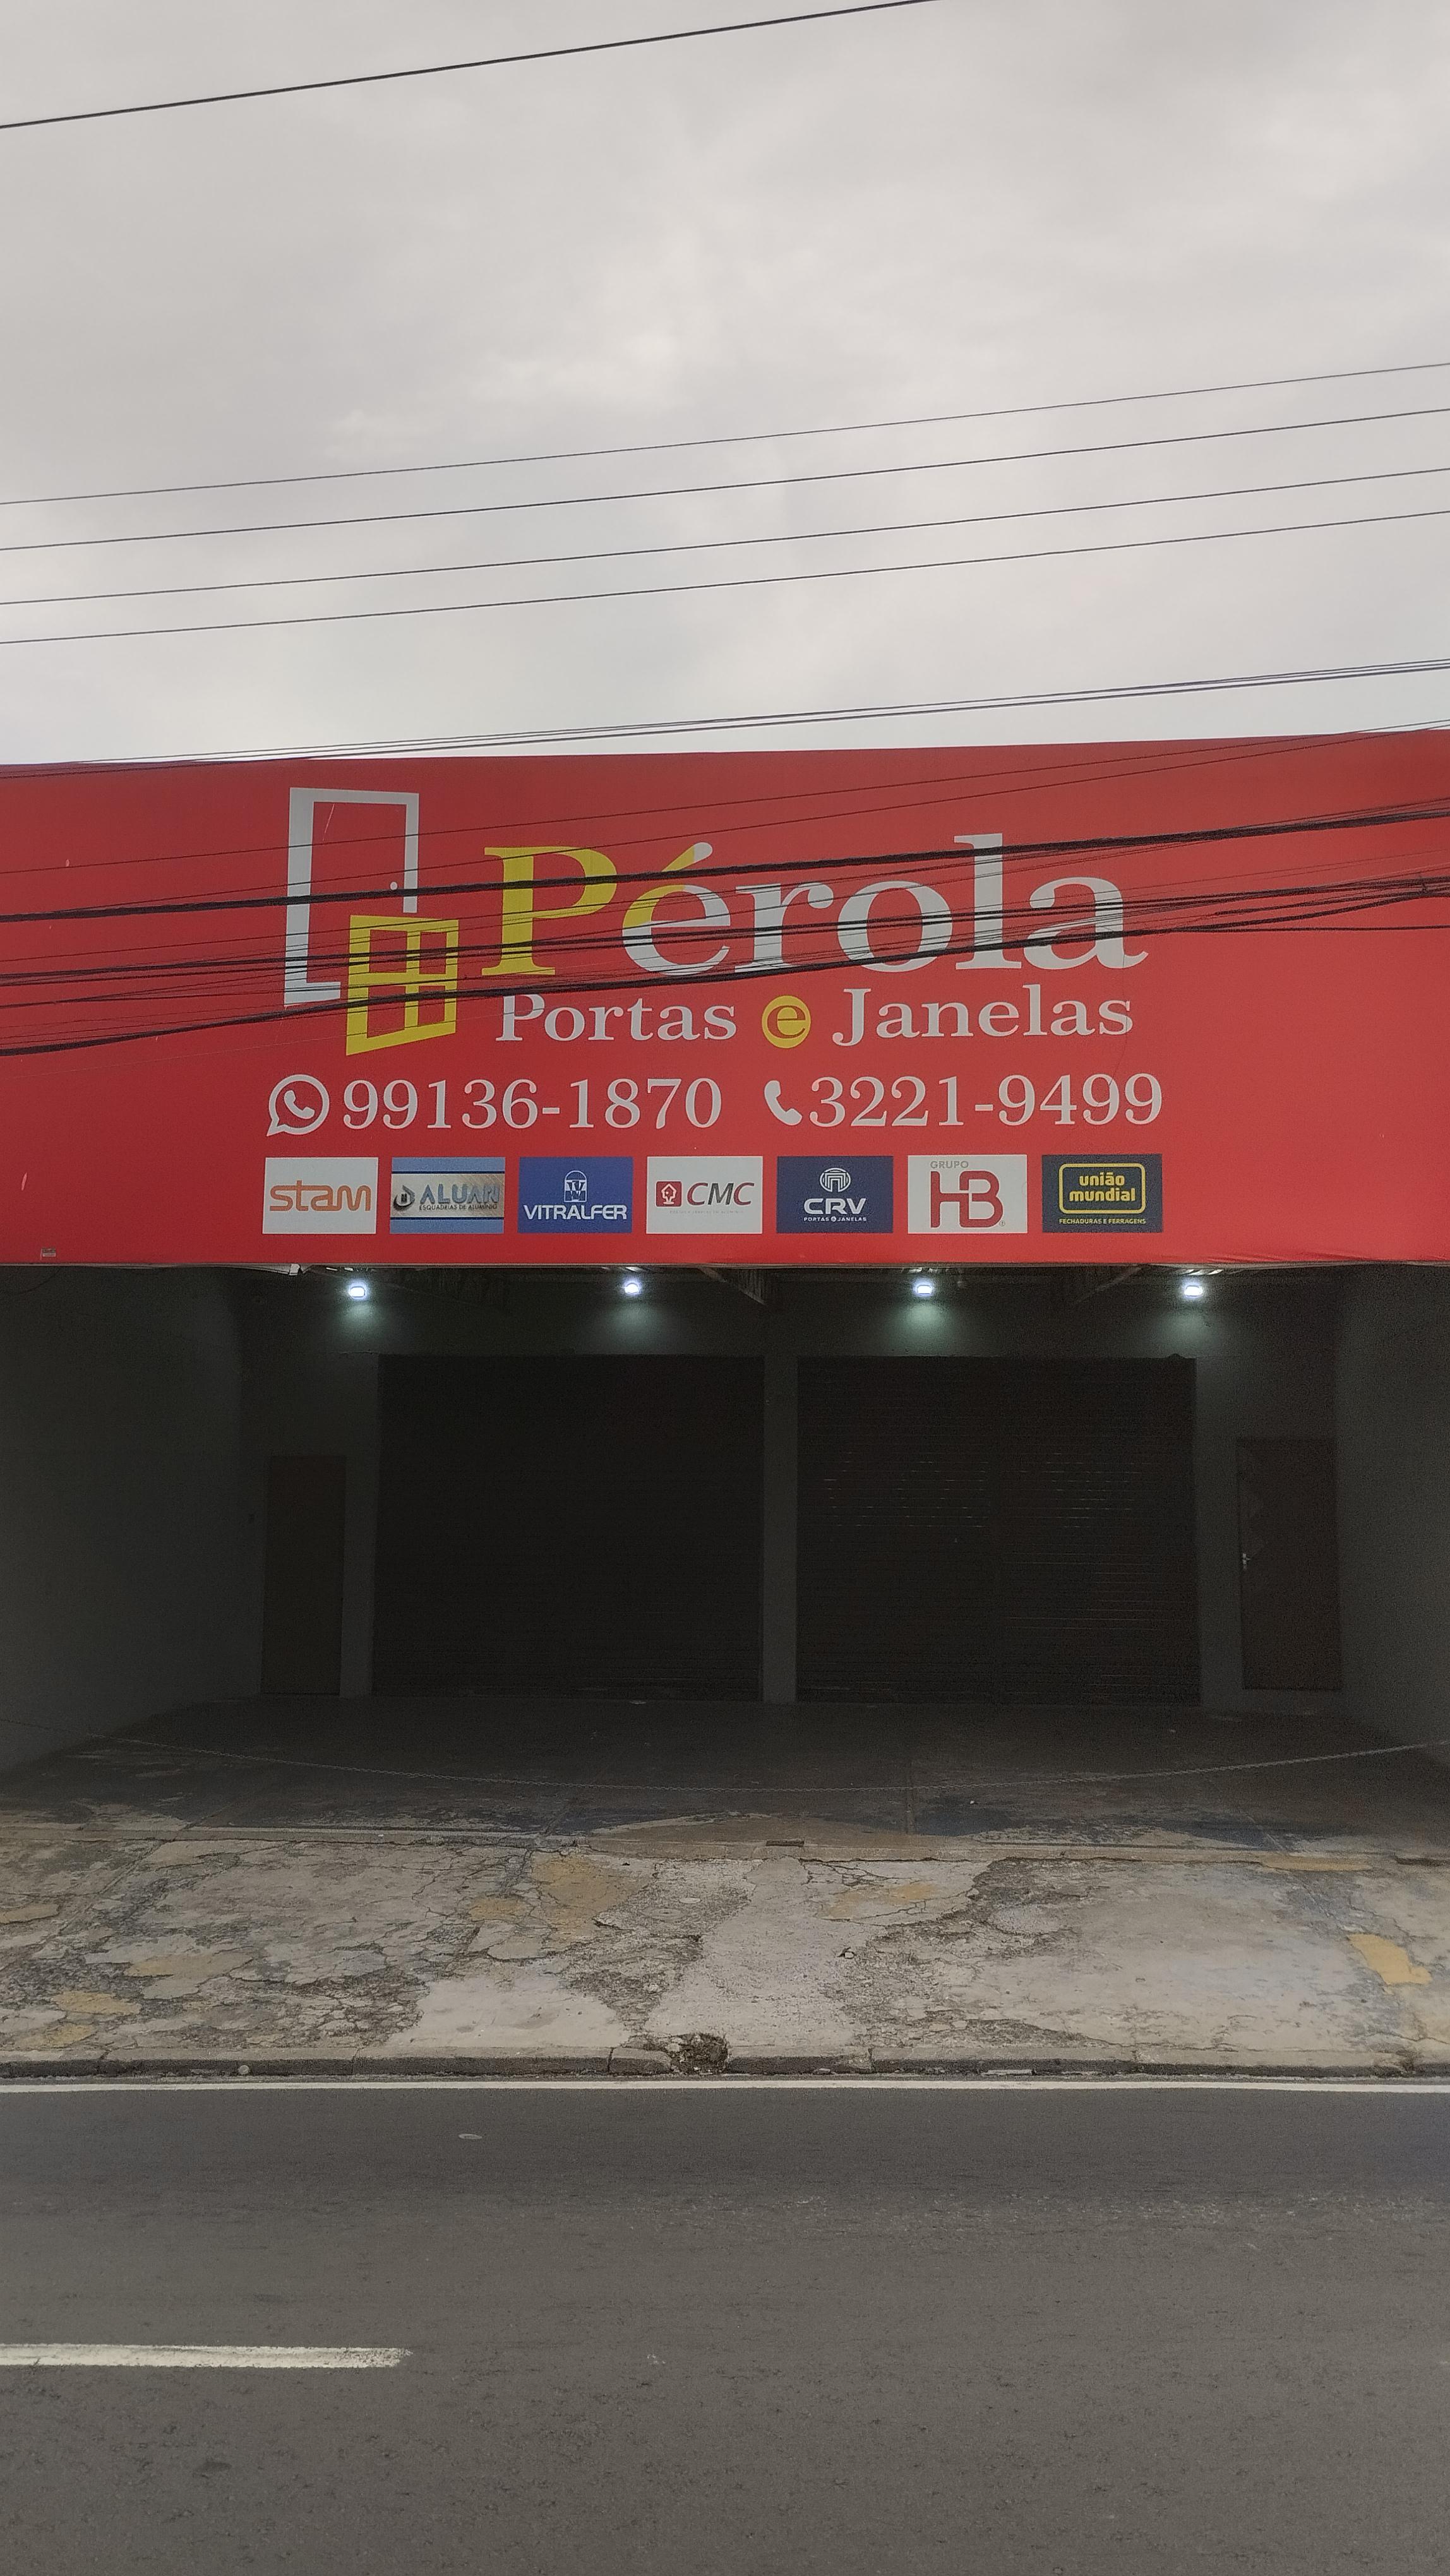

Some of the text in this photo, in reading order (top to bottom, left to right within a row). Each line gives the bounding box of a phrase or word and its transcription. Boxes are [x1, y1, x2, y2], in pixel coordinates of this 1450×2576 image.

[482, 832, 1149, 976] Pérola
[495, 984, 1134, 1049] Portas e Janelas
[343, 1077, 722, 1131] 99136-1870
[808, 1073, 1163, 1128] 3221-9499
[930, 1160, 969, 1169] GRUPO
[1079, 1171, 1125, 1186] união
[270, 1179, 371, 1212] stam
[686, 1182, 755, 1206] CMC
[804, 1198, 866, 1215] CRV
[930, 1171, 1003, 1228] HB
[1069, 1188, 1135, 1202] mundial
[524, 1205, 627, 1220] VITRALFER
